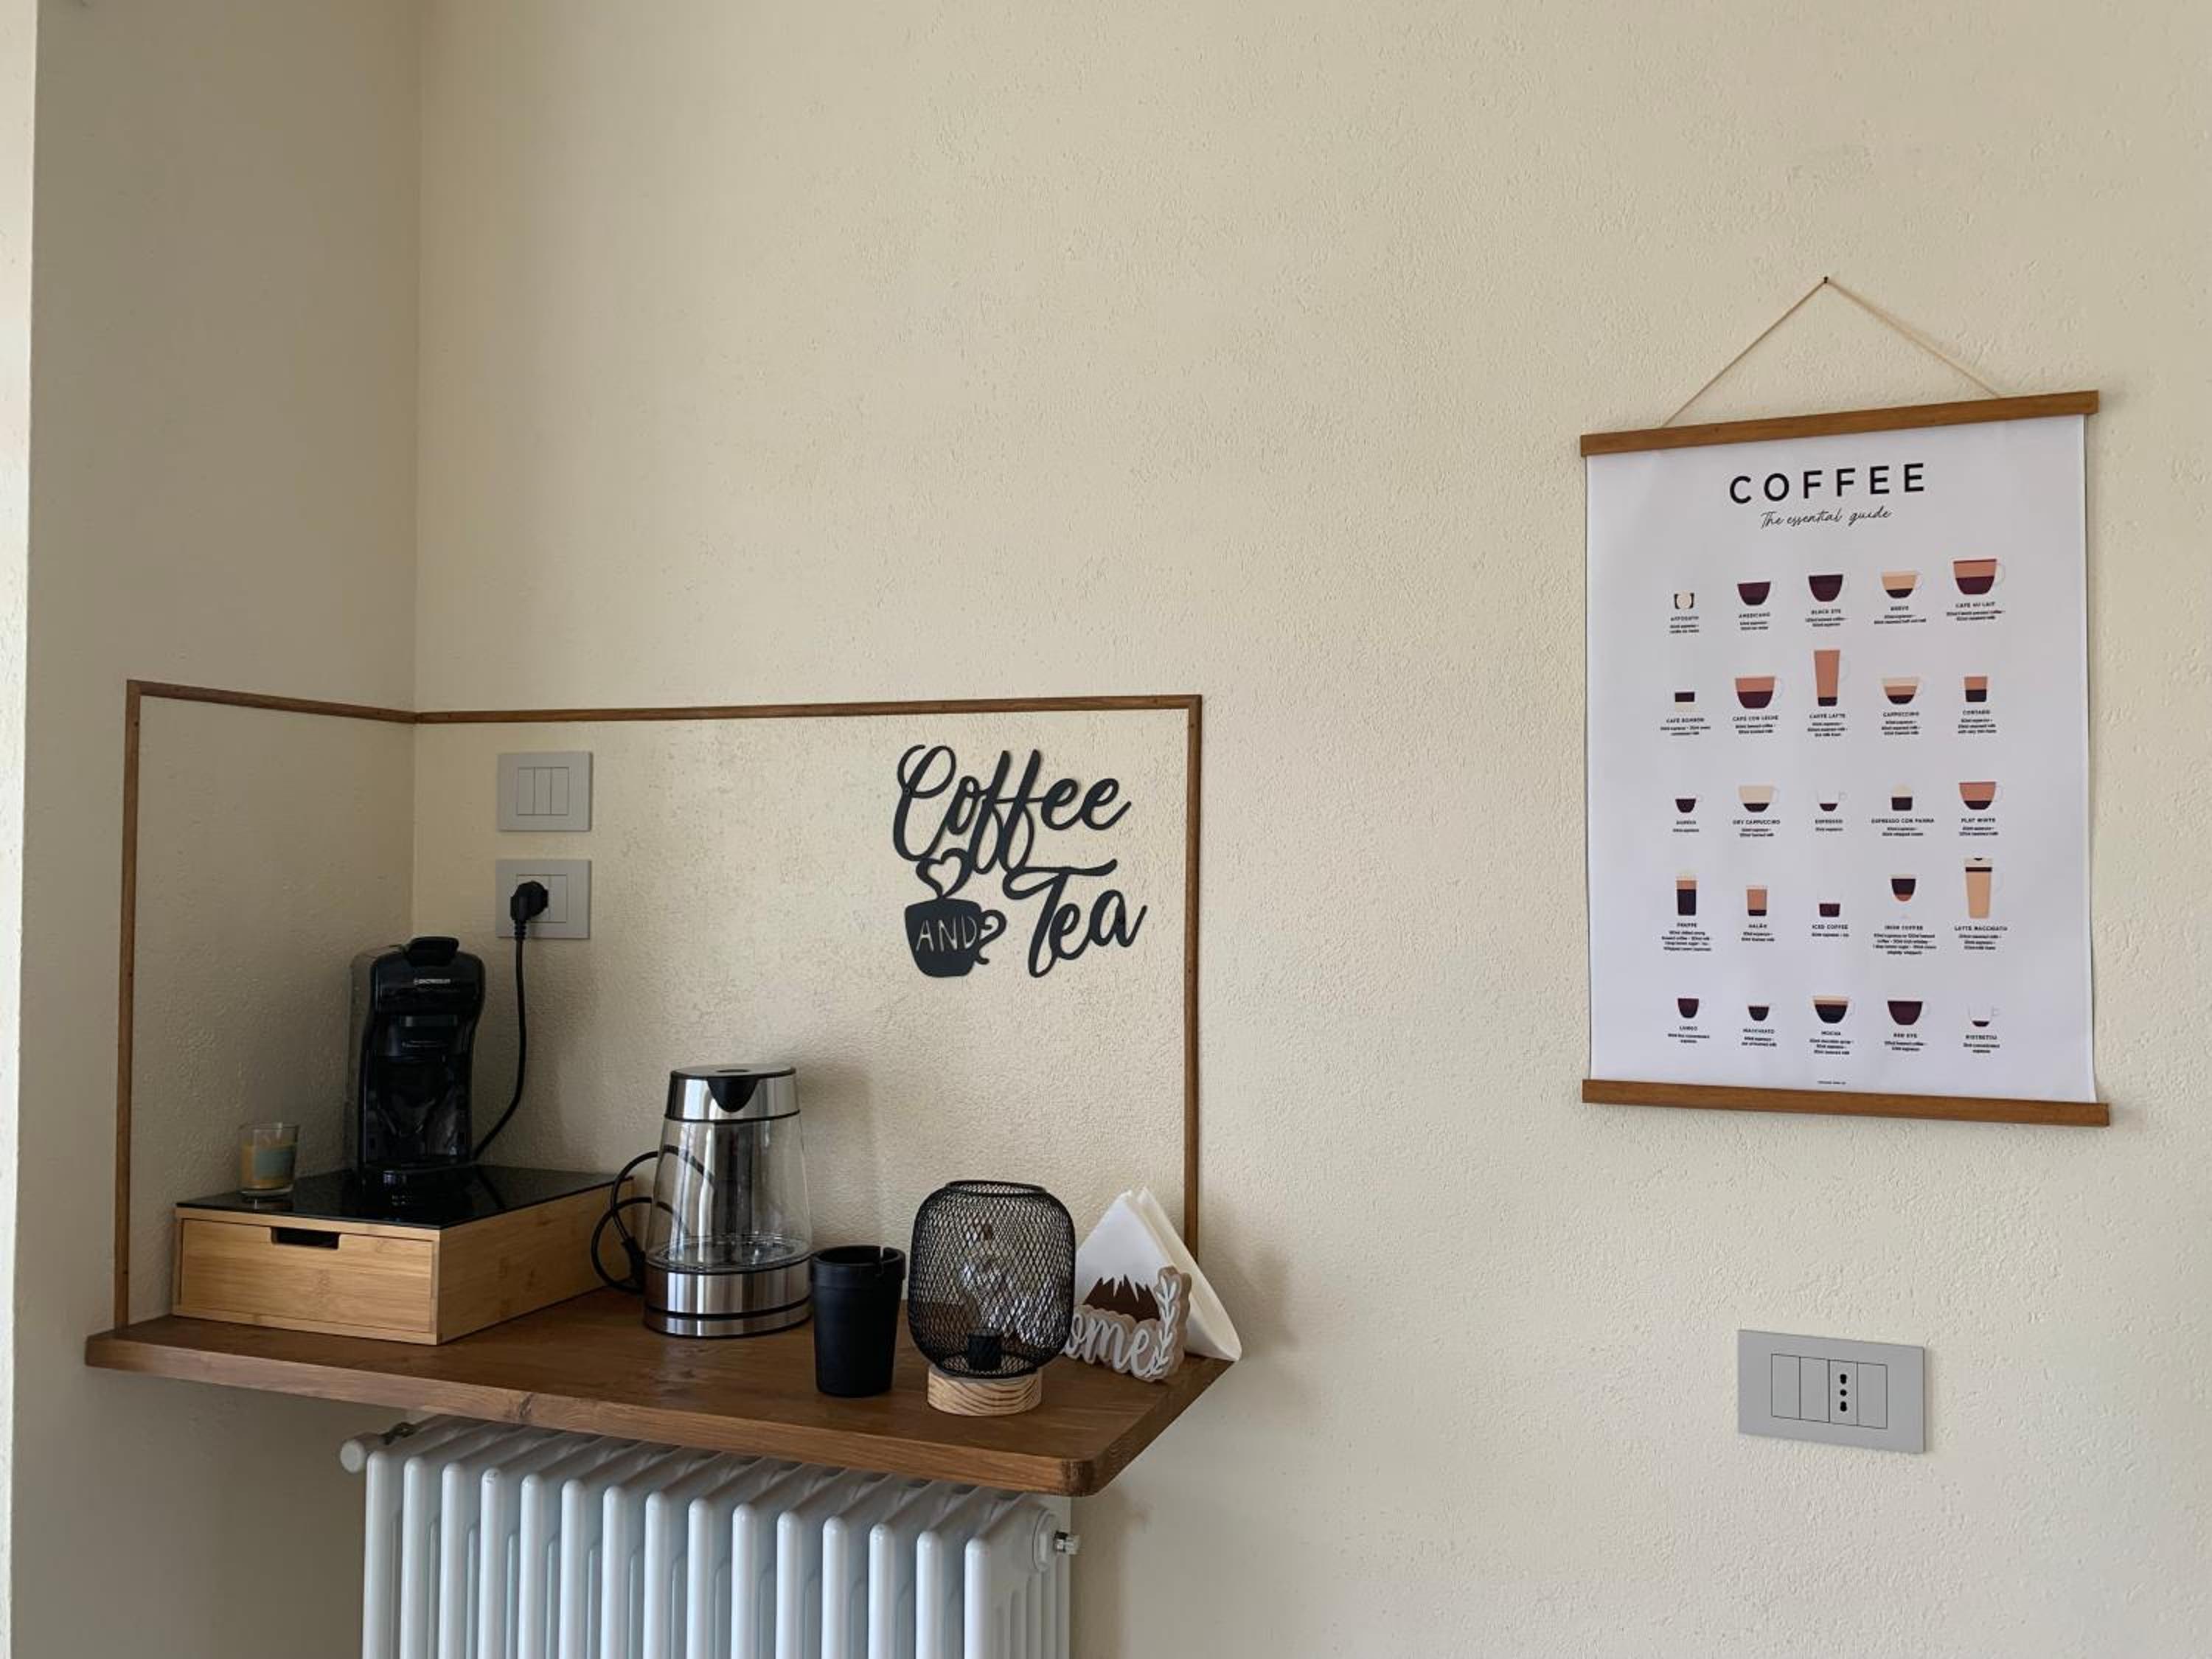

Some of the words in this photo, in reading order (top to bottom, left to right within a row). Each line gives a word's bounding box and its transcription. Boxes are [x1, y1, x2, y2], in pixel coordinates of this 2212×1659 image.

[1730, 462, 1924, 504] COFFEE
[1761, 511, 1784, 529] The
[1787, 508, 1842, 526] essential
[1848, 505, 1892, 526] guide
[893, 744, 1132, 875] Coffee
[915, 915, 978, 952] AND
[1002, 858, 1147, 978] Tea
